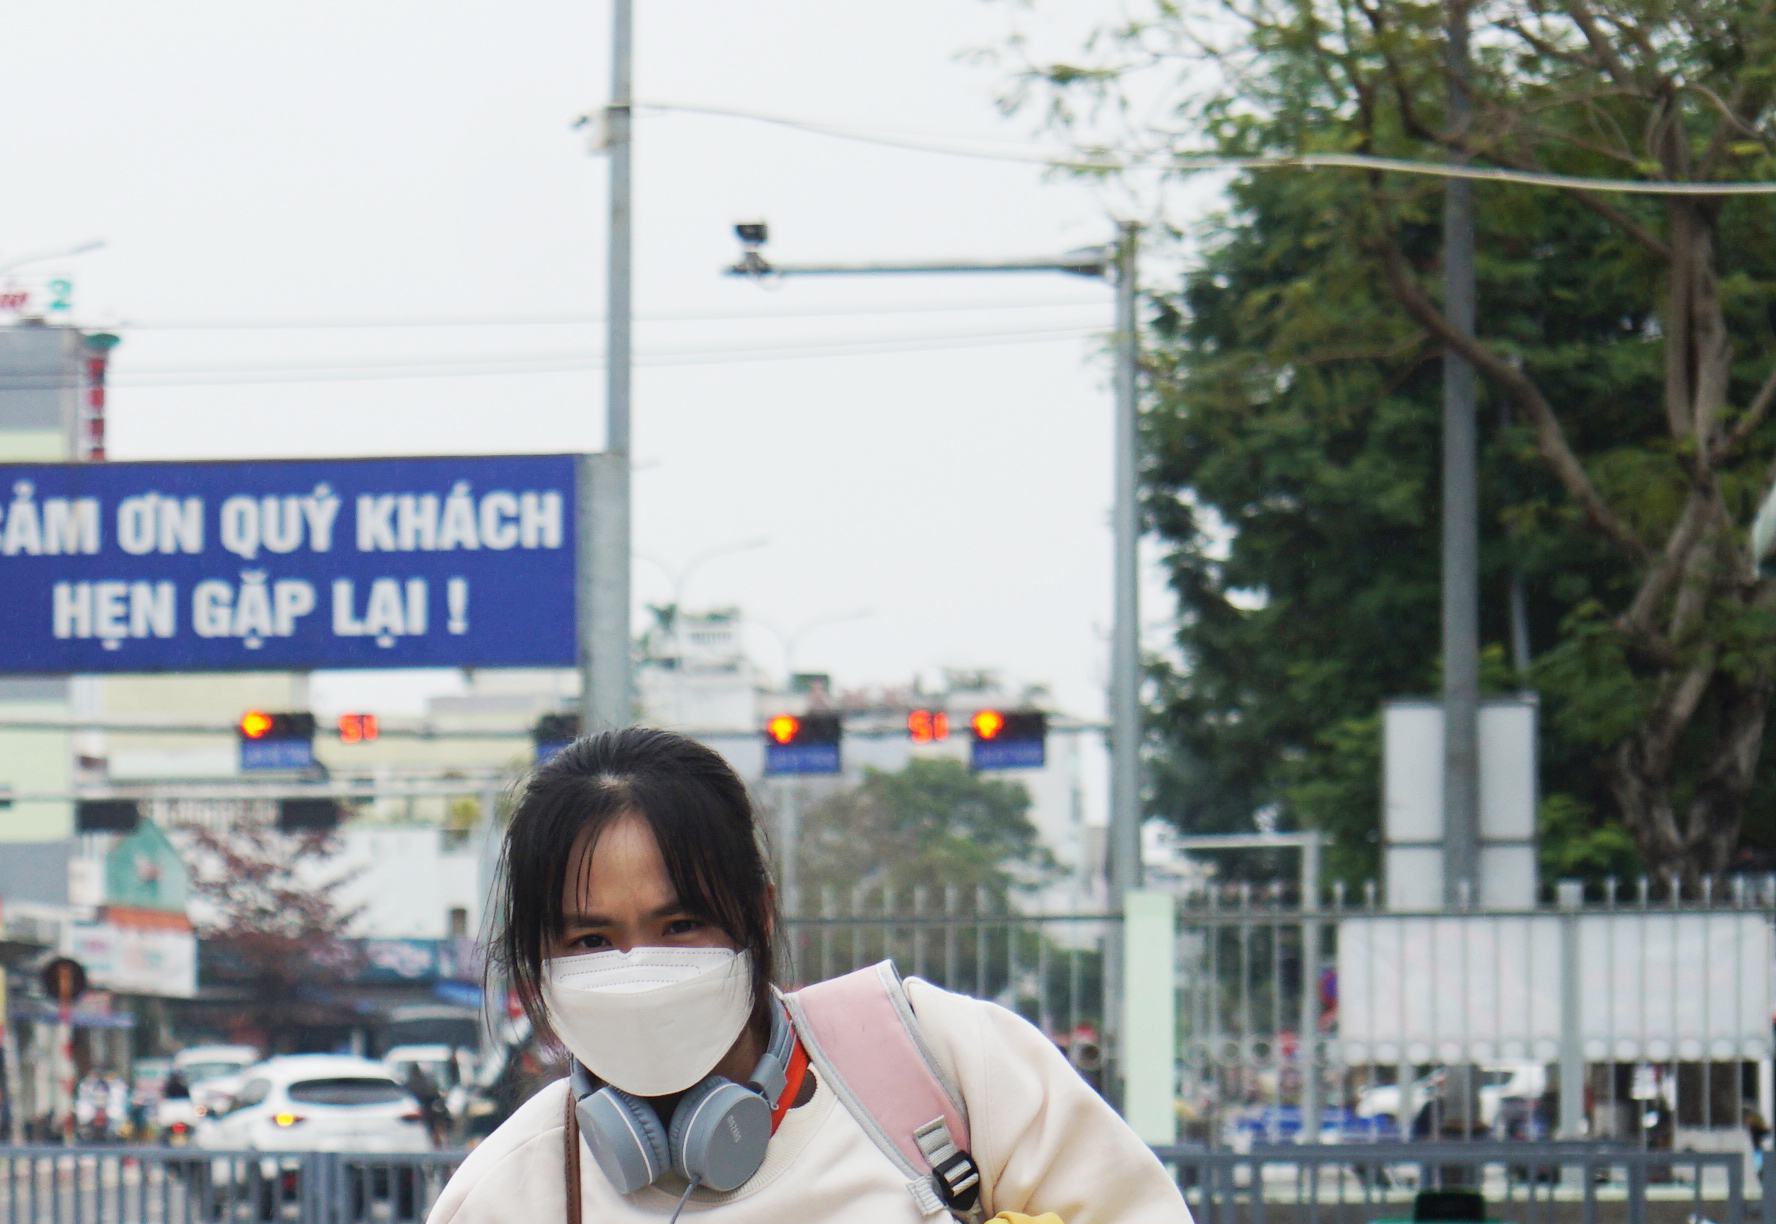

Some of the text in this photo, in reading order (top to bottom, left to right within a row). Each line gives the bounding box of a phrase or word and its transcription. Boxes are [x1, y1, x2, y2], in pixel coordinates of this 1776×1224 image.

[48, 276, 73, 311] 2
[118, 491, 204, 556] ƠN
[220, 482, 340, 560] QUÝ
[355, 480, 565, 553] KHÁCH
[52, 568, 469, 650] HẸN GẶP LẠI !
